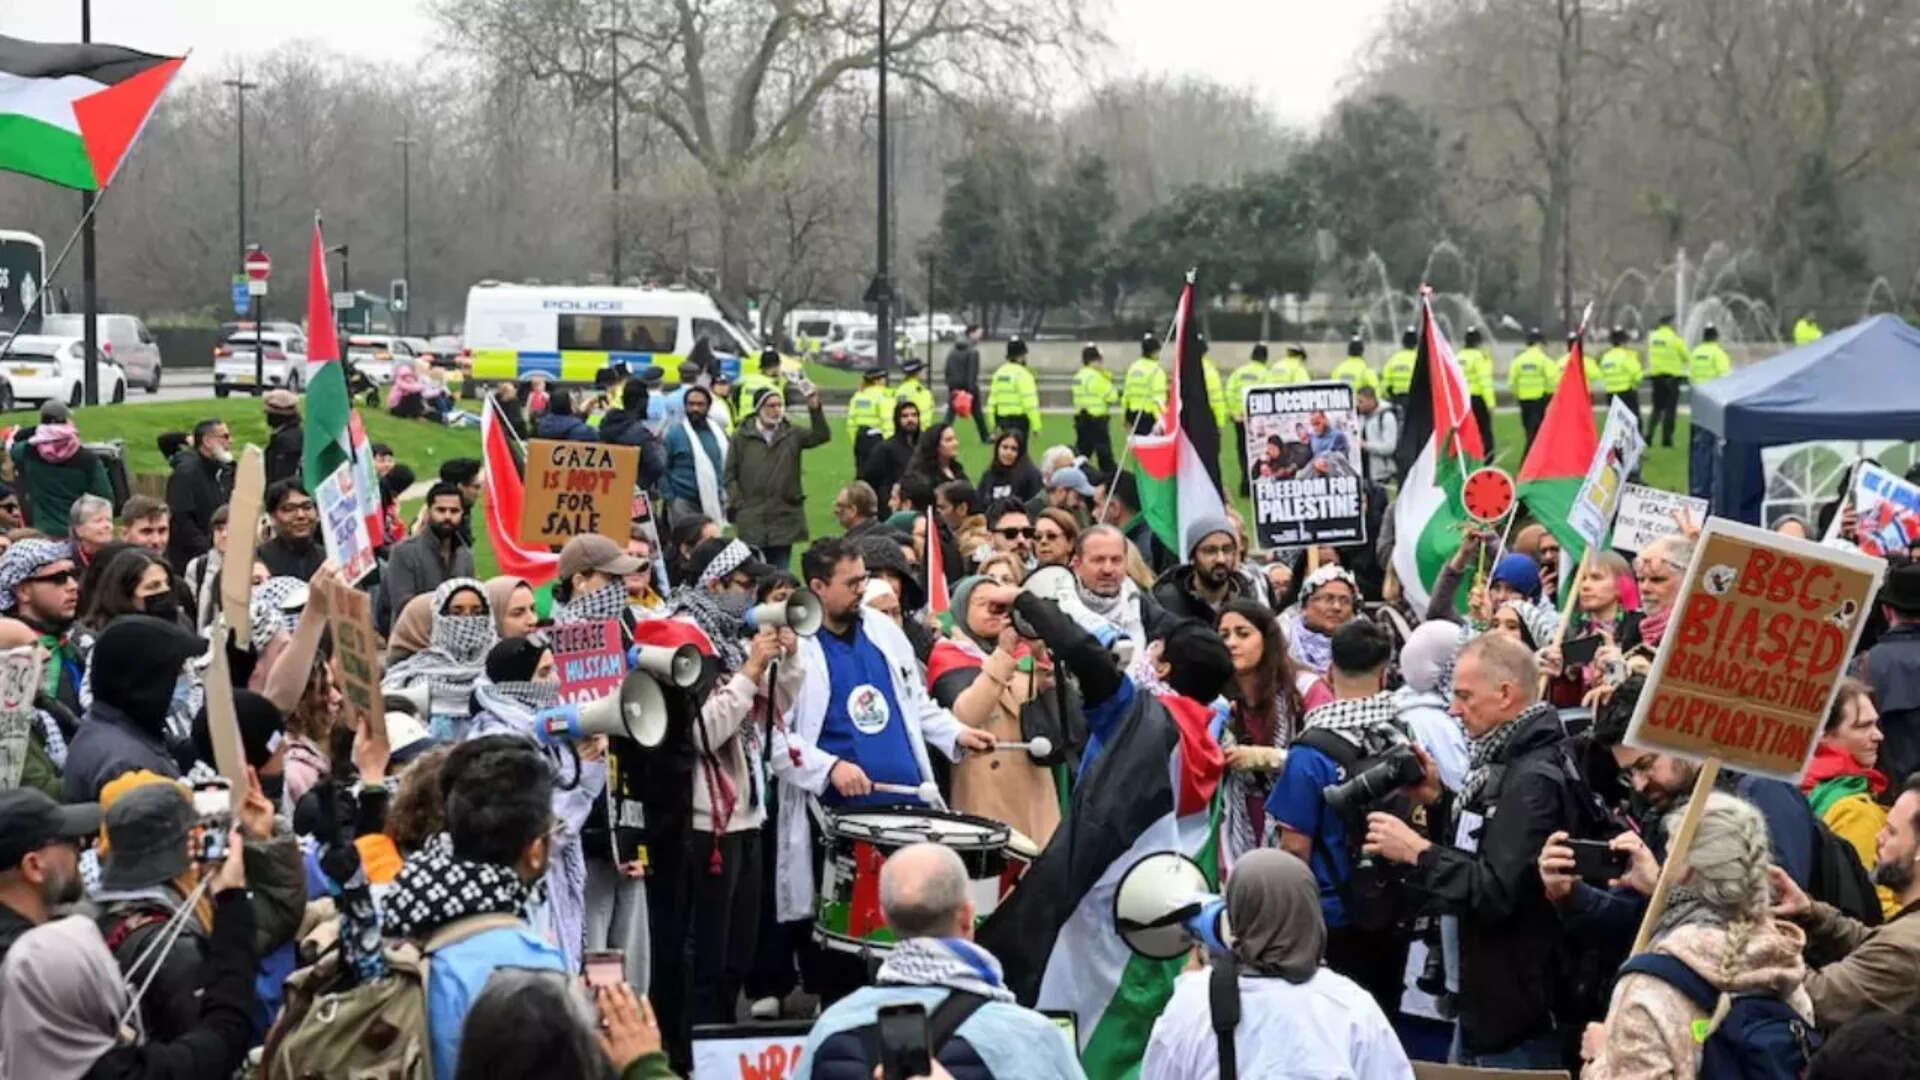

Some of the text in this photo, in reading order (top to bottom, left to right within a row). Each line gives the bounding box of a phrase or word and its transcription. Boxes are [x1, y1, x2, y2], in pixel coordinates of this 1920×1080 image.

[542, 299, 622, 311] POLICE
[1250, 388, 1350, 414] END OCCUPATION
[551, 445, 612, 468] GAZA
[542, 468, 616, 494] IS NOT
[1257, 475, 1357, 500] FREEDOM FOR
[555, 493, 593, 512] FOR
[1258, 494, 1360, 525] PALESTINE
[541, 511, 600, 536] SALE
[1678, 593, 1845, 676] BIASED
[565, 654, 622, 683] HUSSAM
[1665, 648, 1830, 714] BROADCASTING
[1647, 692, 1818, 763] CORPORATION
